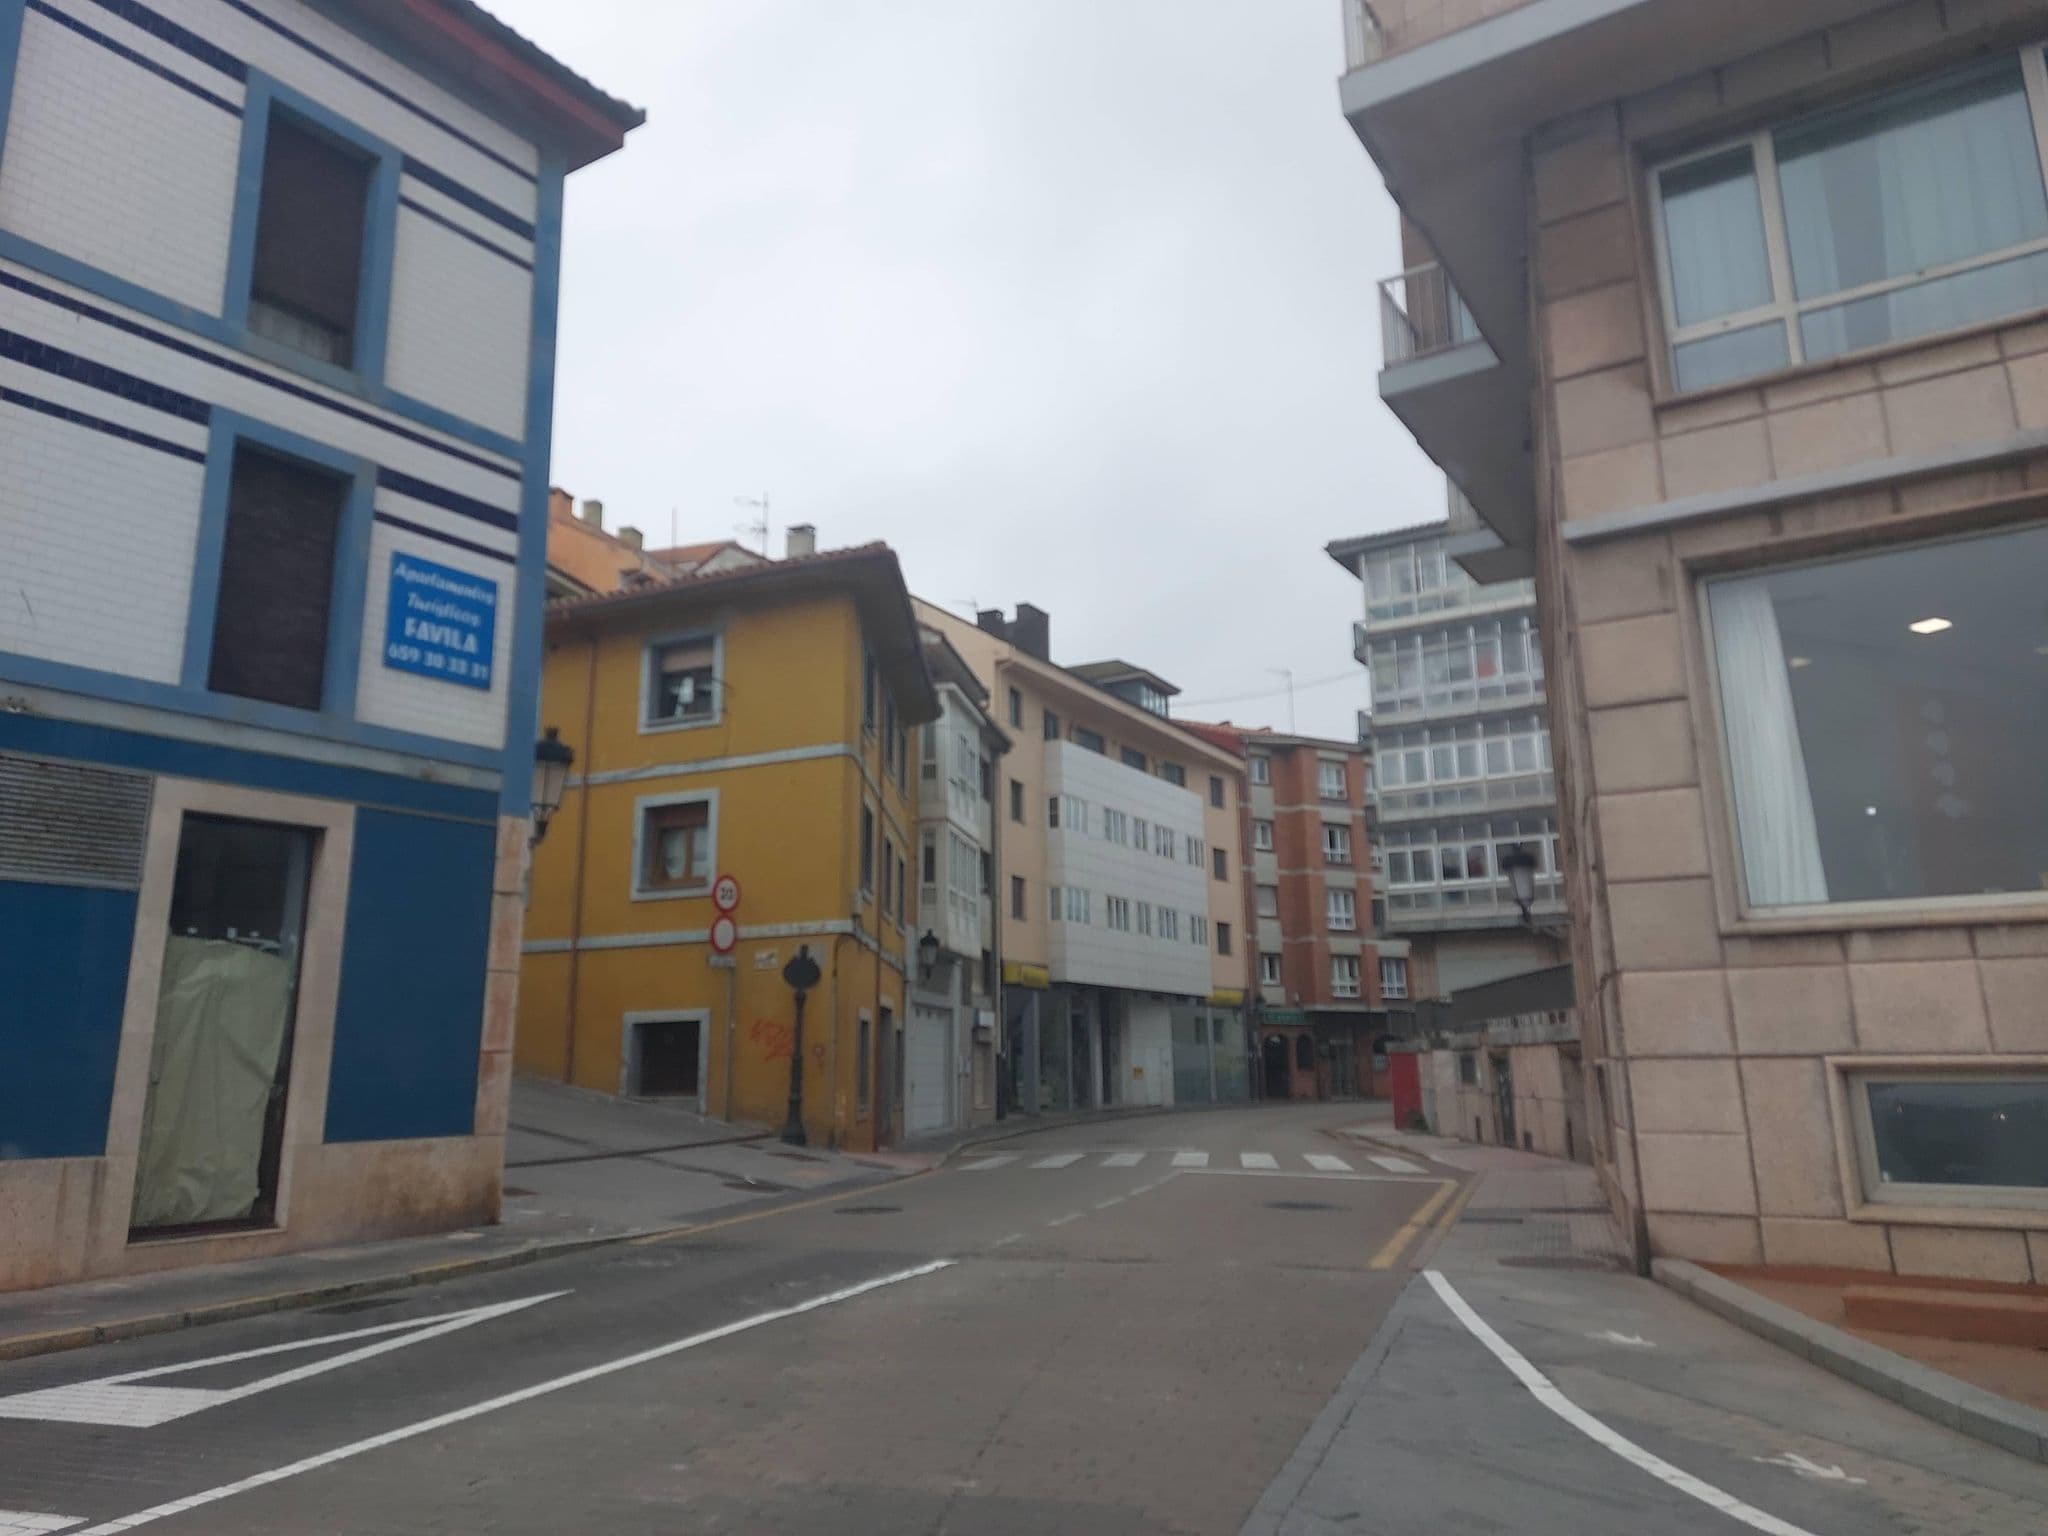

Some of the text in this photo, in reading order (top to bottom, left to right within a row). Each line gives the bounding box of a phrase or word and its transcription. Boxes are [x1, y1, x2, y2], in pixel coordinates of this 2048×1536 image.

[395, 563, 495, 604] Apartamentos
[389, 643, 421, 663] 659
[405, 617, 478, 654] FAVILA
